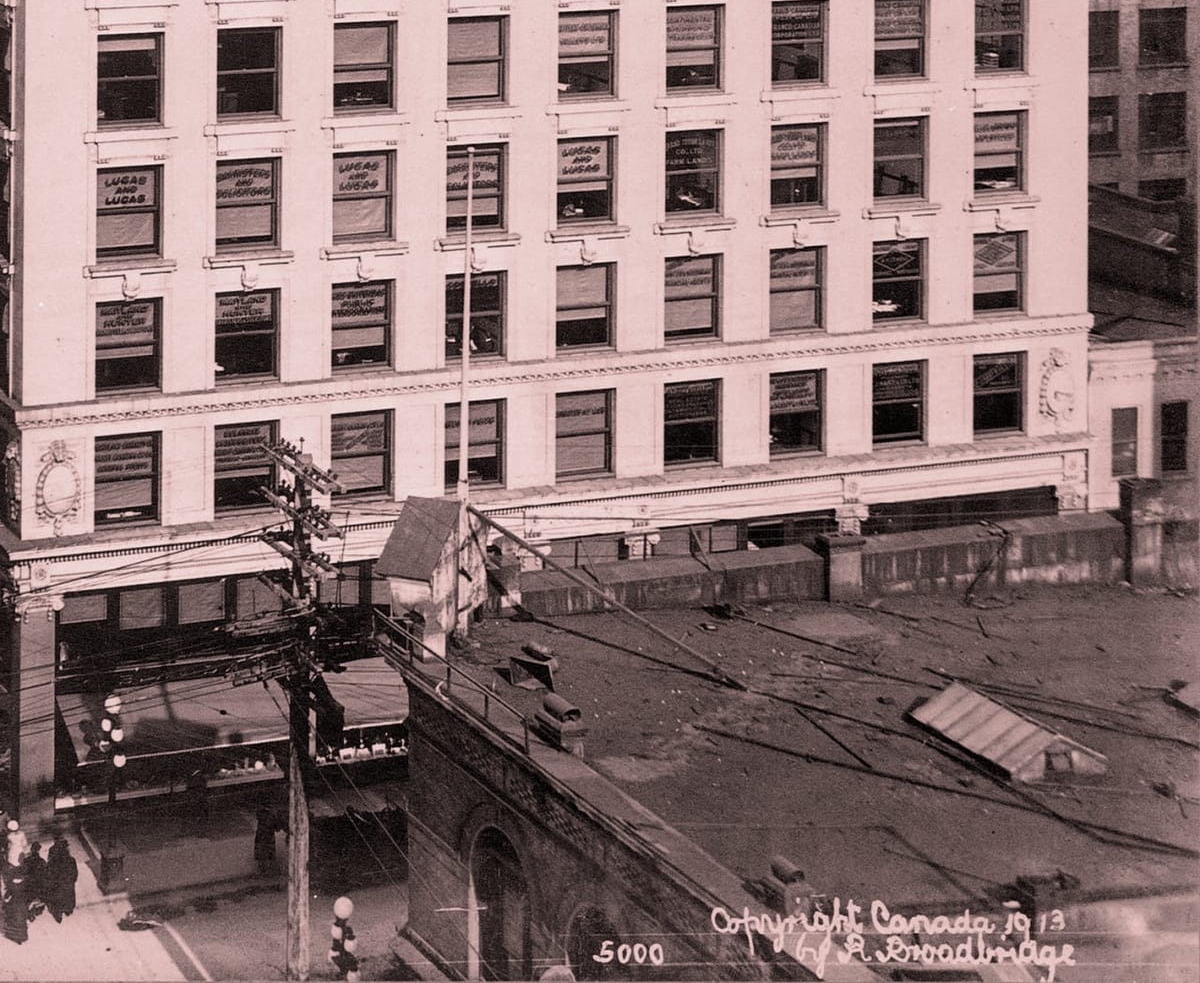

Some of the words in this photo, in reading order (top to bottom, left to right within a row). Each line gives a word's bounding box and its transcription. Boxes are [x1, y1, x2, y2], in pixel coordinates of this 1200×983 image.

[561, 146, 601, 157] LUCAS
[571, 156, 593, 164] AND
[339, 161, 380, 173] LUCAS
[562, 164, 601, 175] LUCAS
[104, 176, 148, 187] LUCAS
[348, 172, 369, 181] AND
[235, 179, 254, 188] AND
[339, 179, 379, 192] LUCAS
[114, 186, 138, 195] AND
[104, 194, 146, 205] LUCAS
